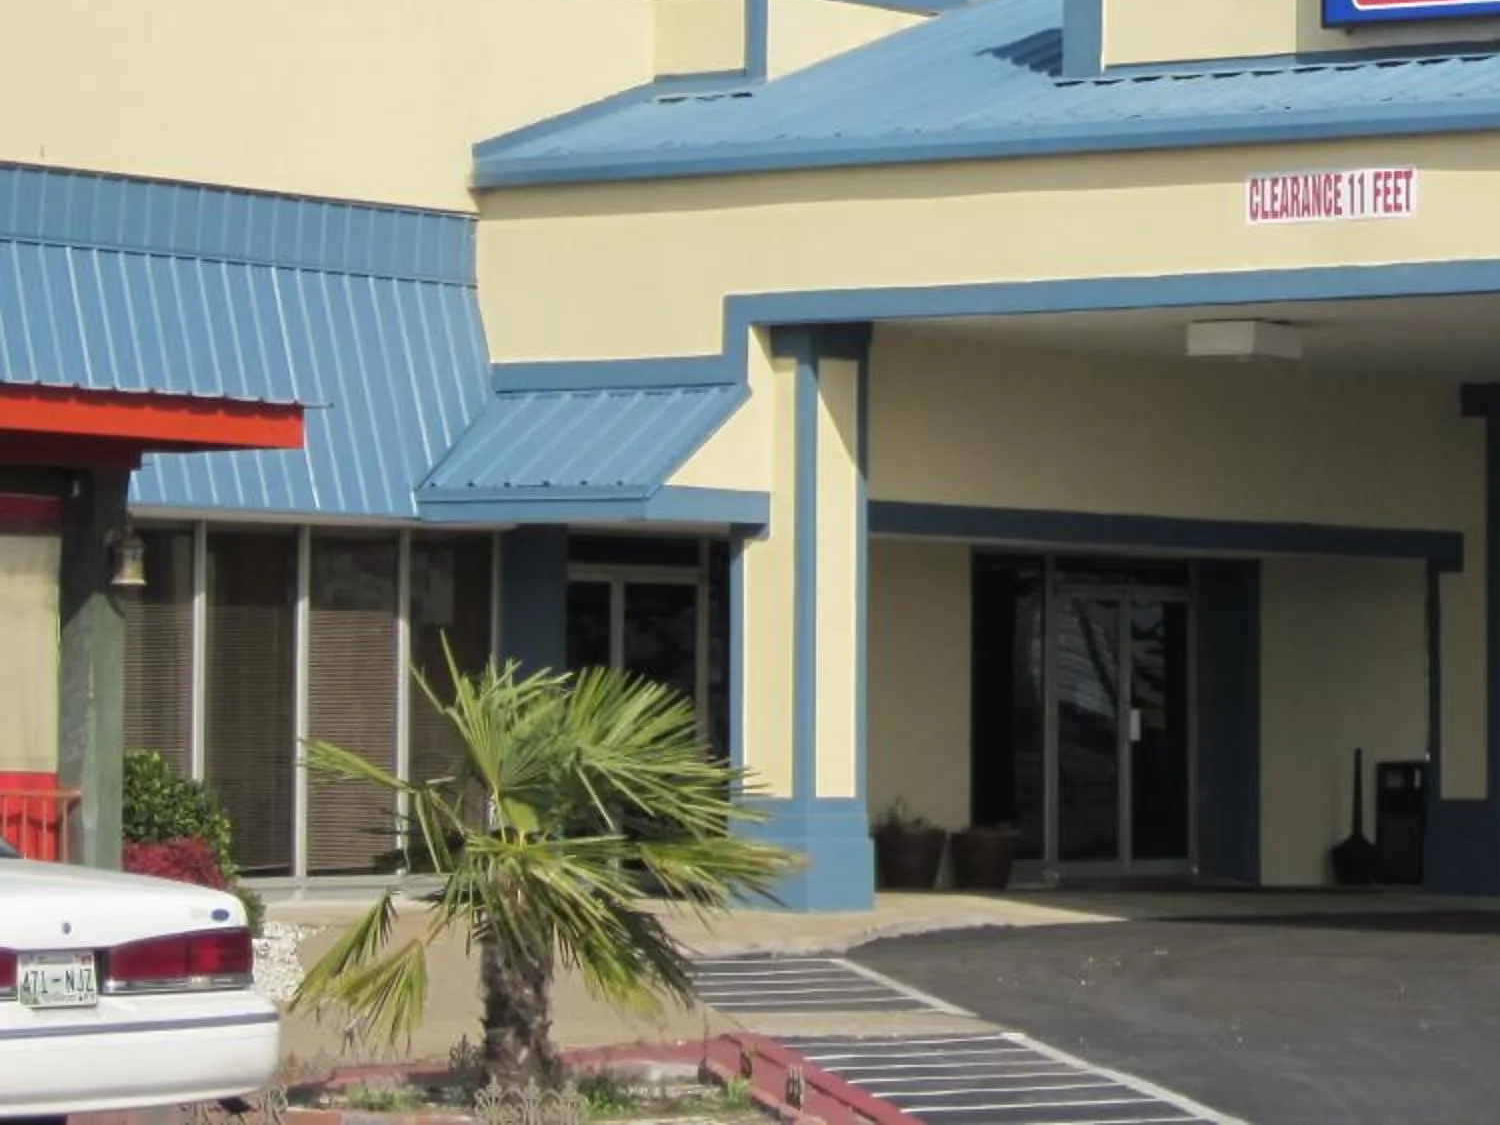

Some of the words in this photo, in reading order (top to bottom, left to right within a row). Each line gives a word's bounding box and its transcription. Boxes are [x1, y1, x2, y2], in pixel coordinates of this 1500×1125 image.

[1249, 173, 1343, 221] CLEARANCE
[1348, 173, 1365, 215] 11
[1373, 170, 1413, 213] FEET
